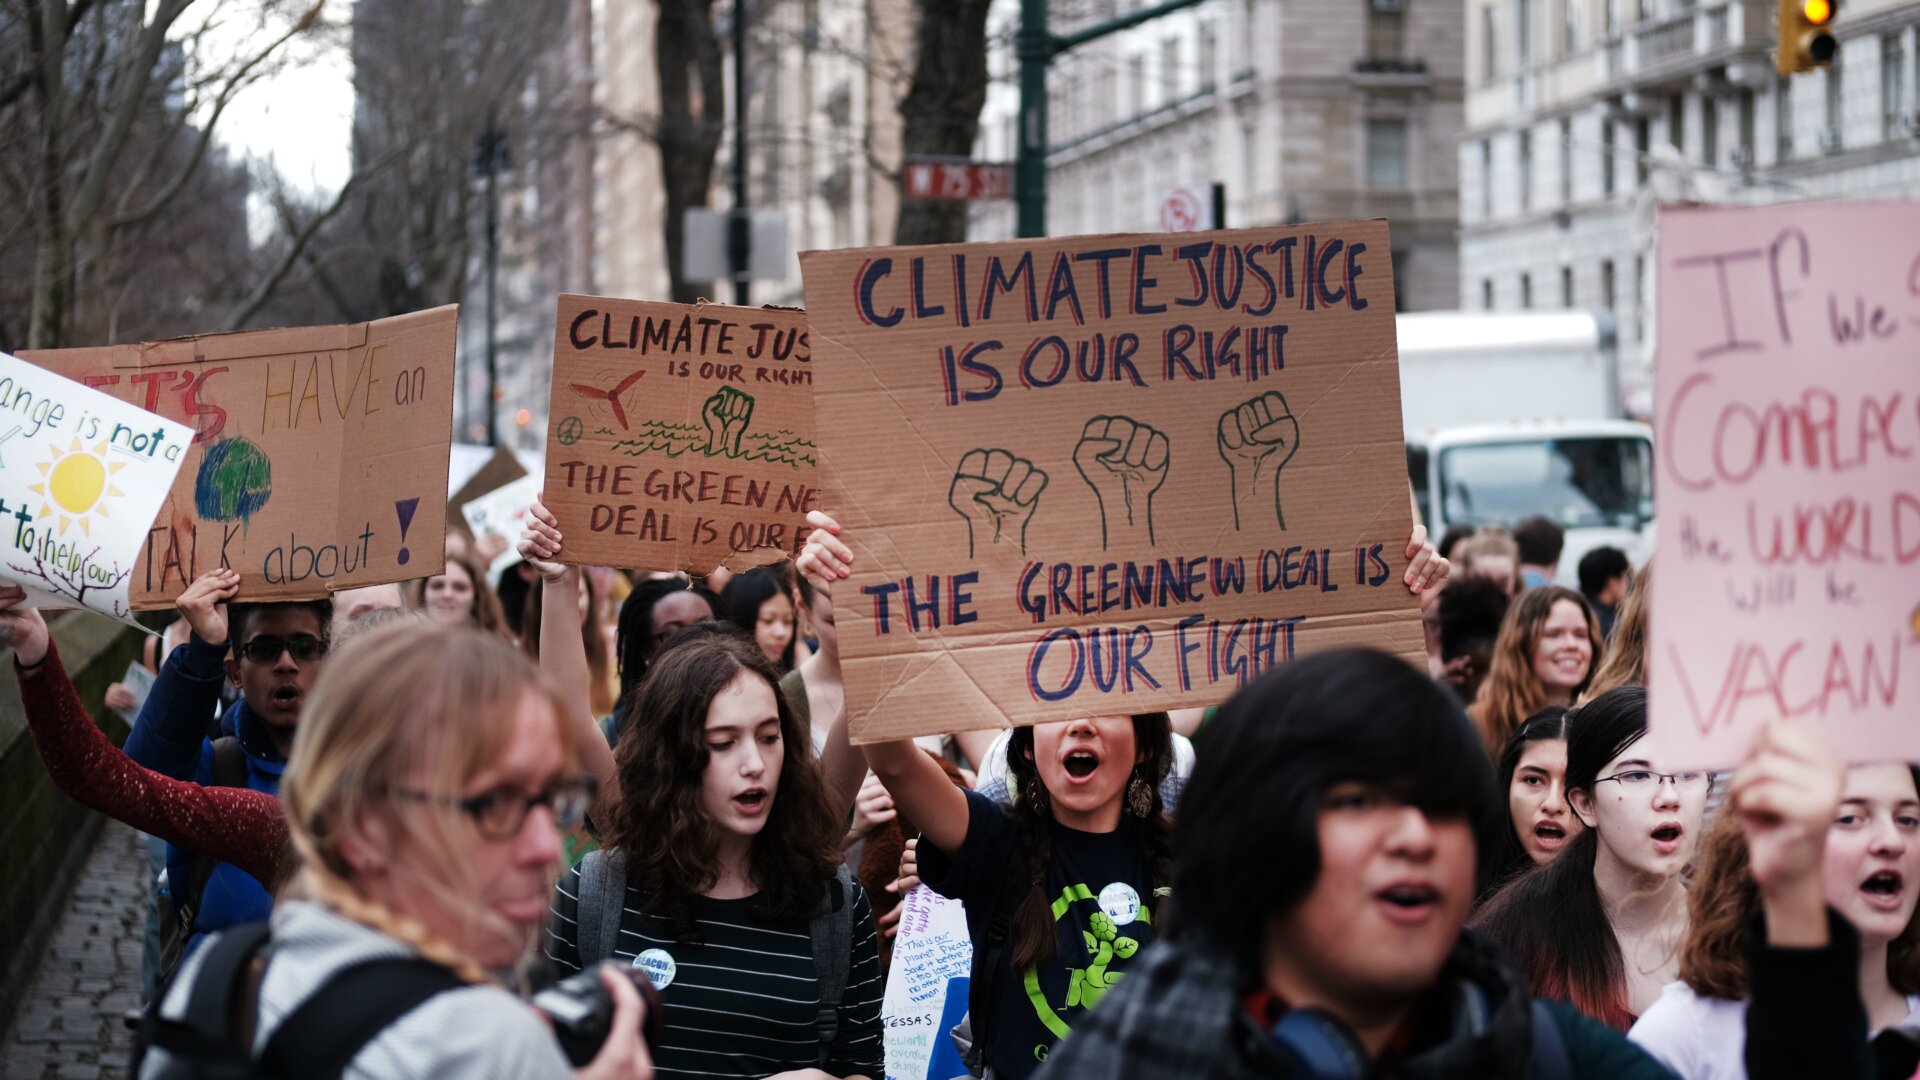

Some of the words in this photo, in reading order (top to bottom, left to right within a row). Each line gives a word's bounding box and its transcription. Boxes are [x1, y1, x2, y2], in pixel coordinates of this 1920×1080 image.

[854, 244, 1167, 327] CLIMATE
[1173, 234, 1368, 317] JUSTICE
[569, 309, 739, 356] CLIMATE
[939, 339, 1004, 406] IS
[1018, 331, 1149, 389] OUR
[1162, 324, 1289, 382] RIGHT
[261, 344, 387, 435] HAVE
[395, 366, 426, 406] an
[668, 360, 690, 377] IS
[700, 361, 746, 384] OUR
[77, 410, 101, 439] is
[110, 427, 164, 457] not
[165, 444, 182, 463] a
[560, 460, 638, 496] THE
[643, 469, 771, 508] GREEN
[15, 504, 35, 553] to
[44, 528, 82, 582] help
[88, 564, 116, 585] our
[590, 504, 677, 542] DEAL
[692, 517, 718, 546] IS
[728, 521, 784, 551] OUR
[1745, 490, 1920, 567] WORLD
[860, 570, 979, 637] THE
[1017, 561, 1154, 623] GREEN
[1154, 556, 1245, 608] NEW
[1256, 545, 1339, 595] DEAL
[1355, 543, 1391, 586] IS
[1027, 624, 1161, 702] OUR
[1174, 614, 1306, 694] FIGHT
[882, 1015, 922, 1029] TESSA
